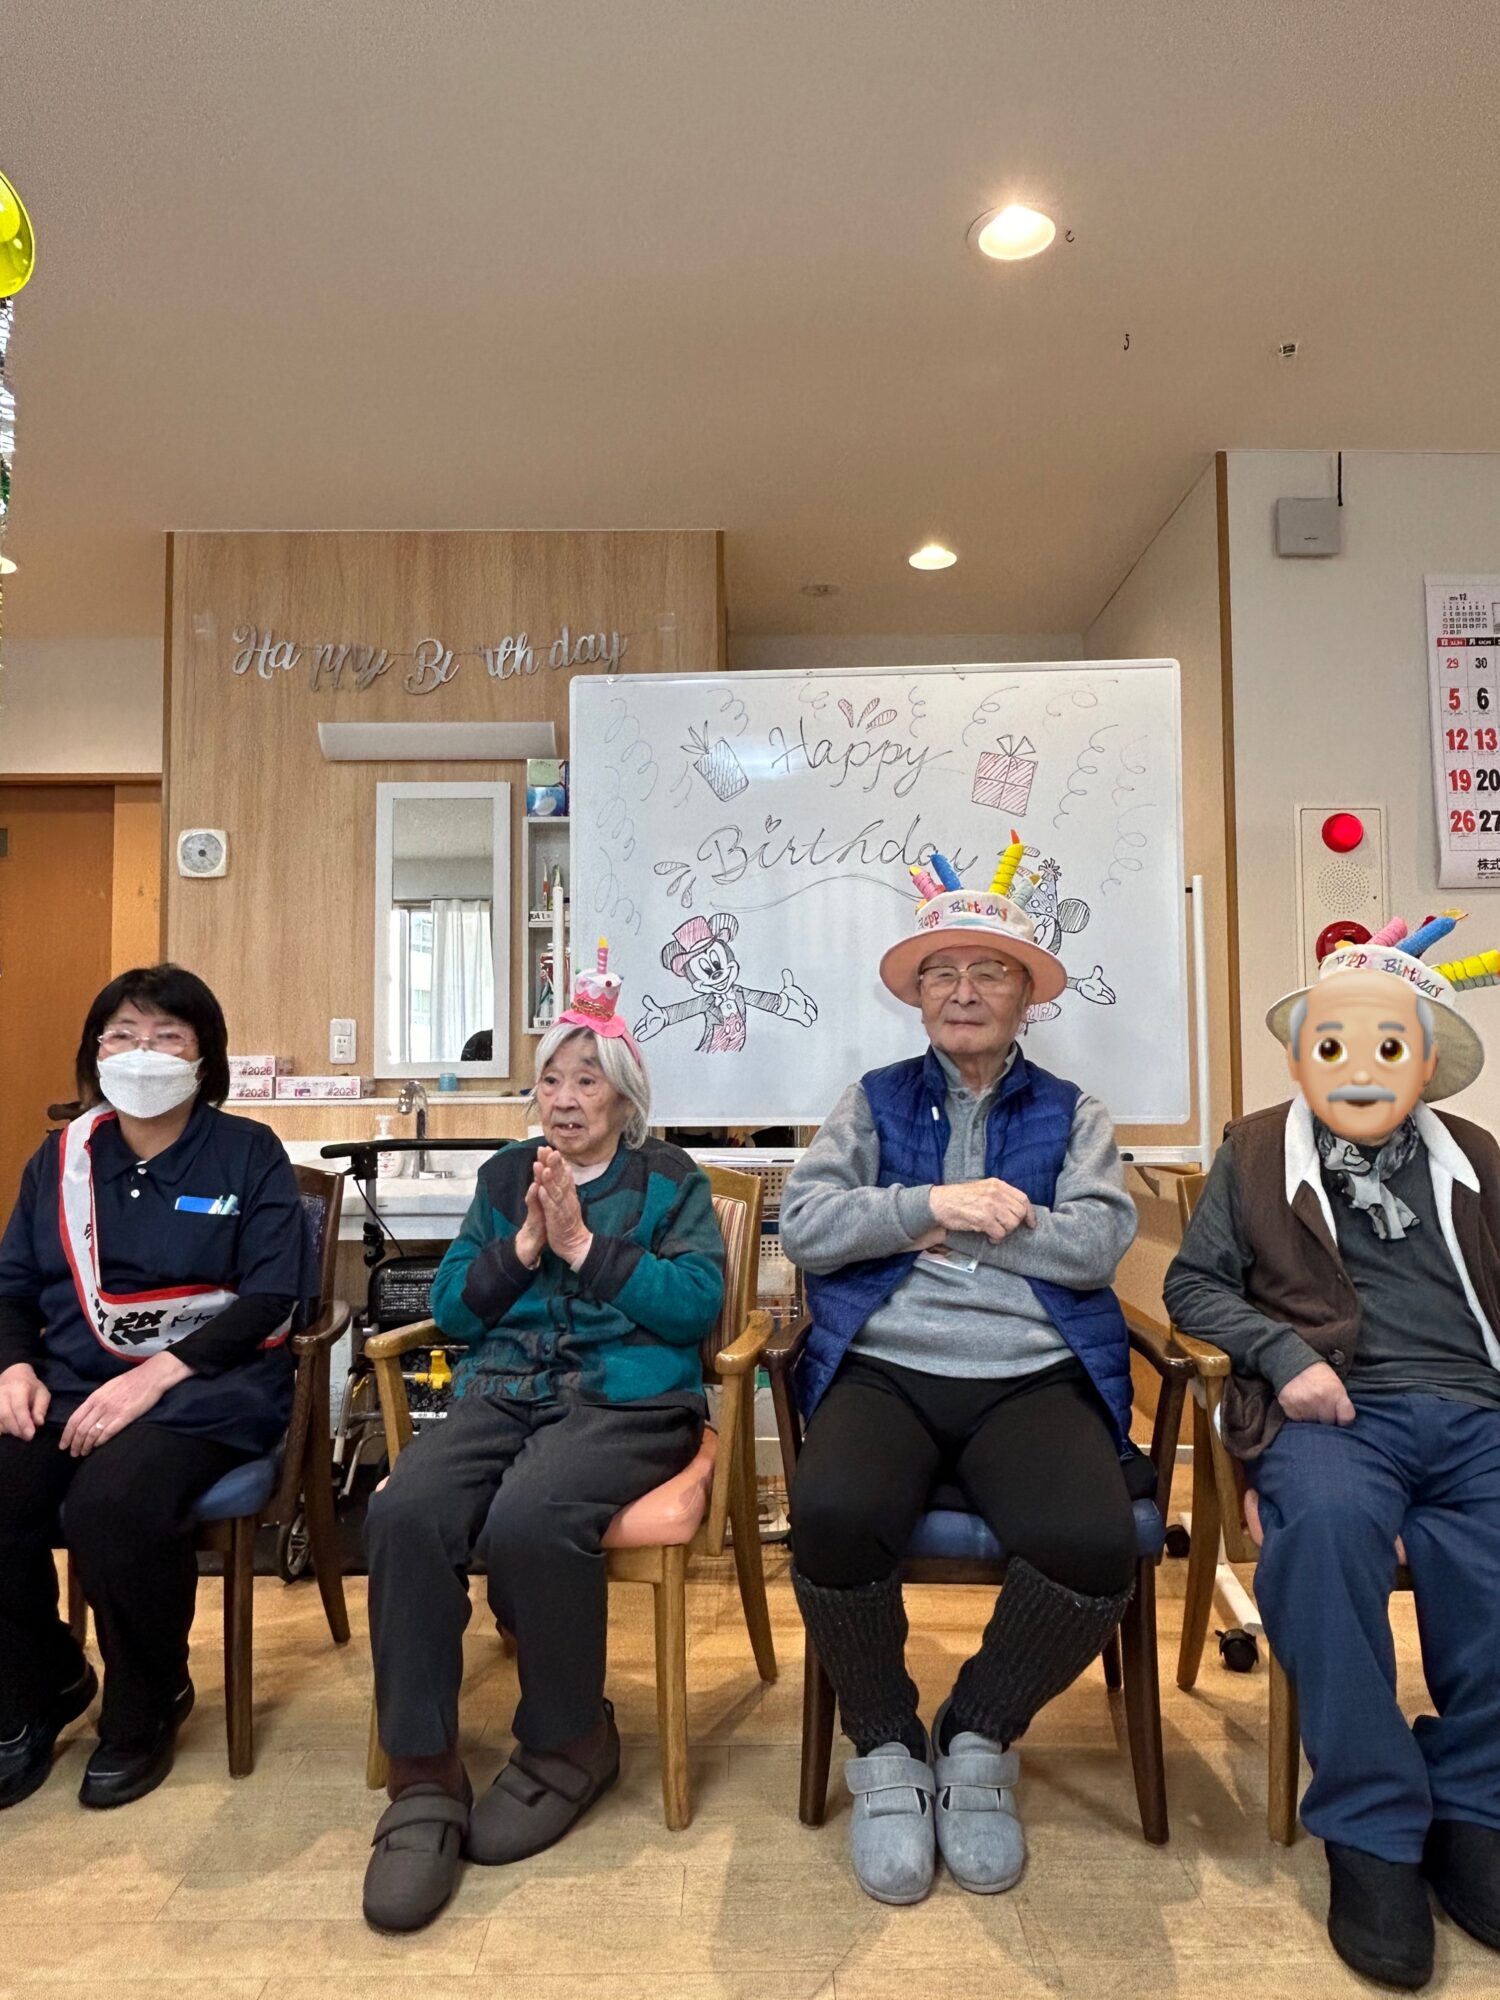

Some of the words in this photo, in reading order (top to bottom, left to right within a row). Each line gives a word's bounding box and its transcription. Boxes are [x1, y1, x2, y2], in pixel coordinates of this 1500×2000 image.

[1446, 658, 1459, 669] 29
[1475, 657, 1488, 669] 30
[1448, 687, 1461, 710] 5
[1476, 687, 1490, 710] 6
[1446, 728, 1469, 750] 12
[1474, 728, 1498, 750] 13
[769, 717, 952, 798] Happy
[1448, 769, 1472, 791] 19
[1476, 769, 1500, 791] 20
[1450, 810, 1476, 833] 26
